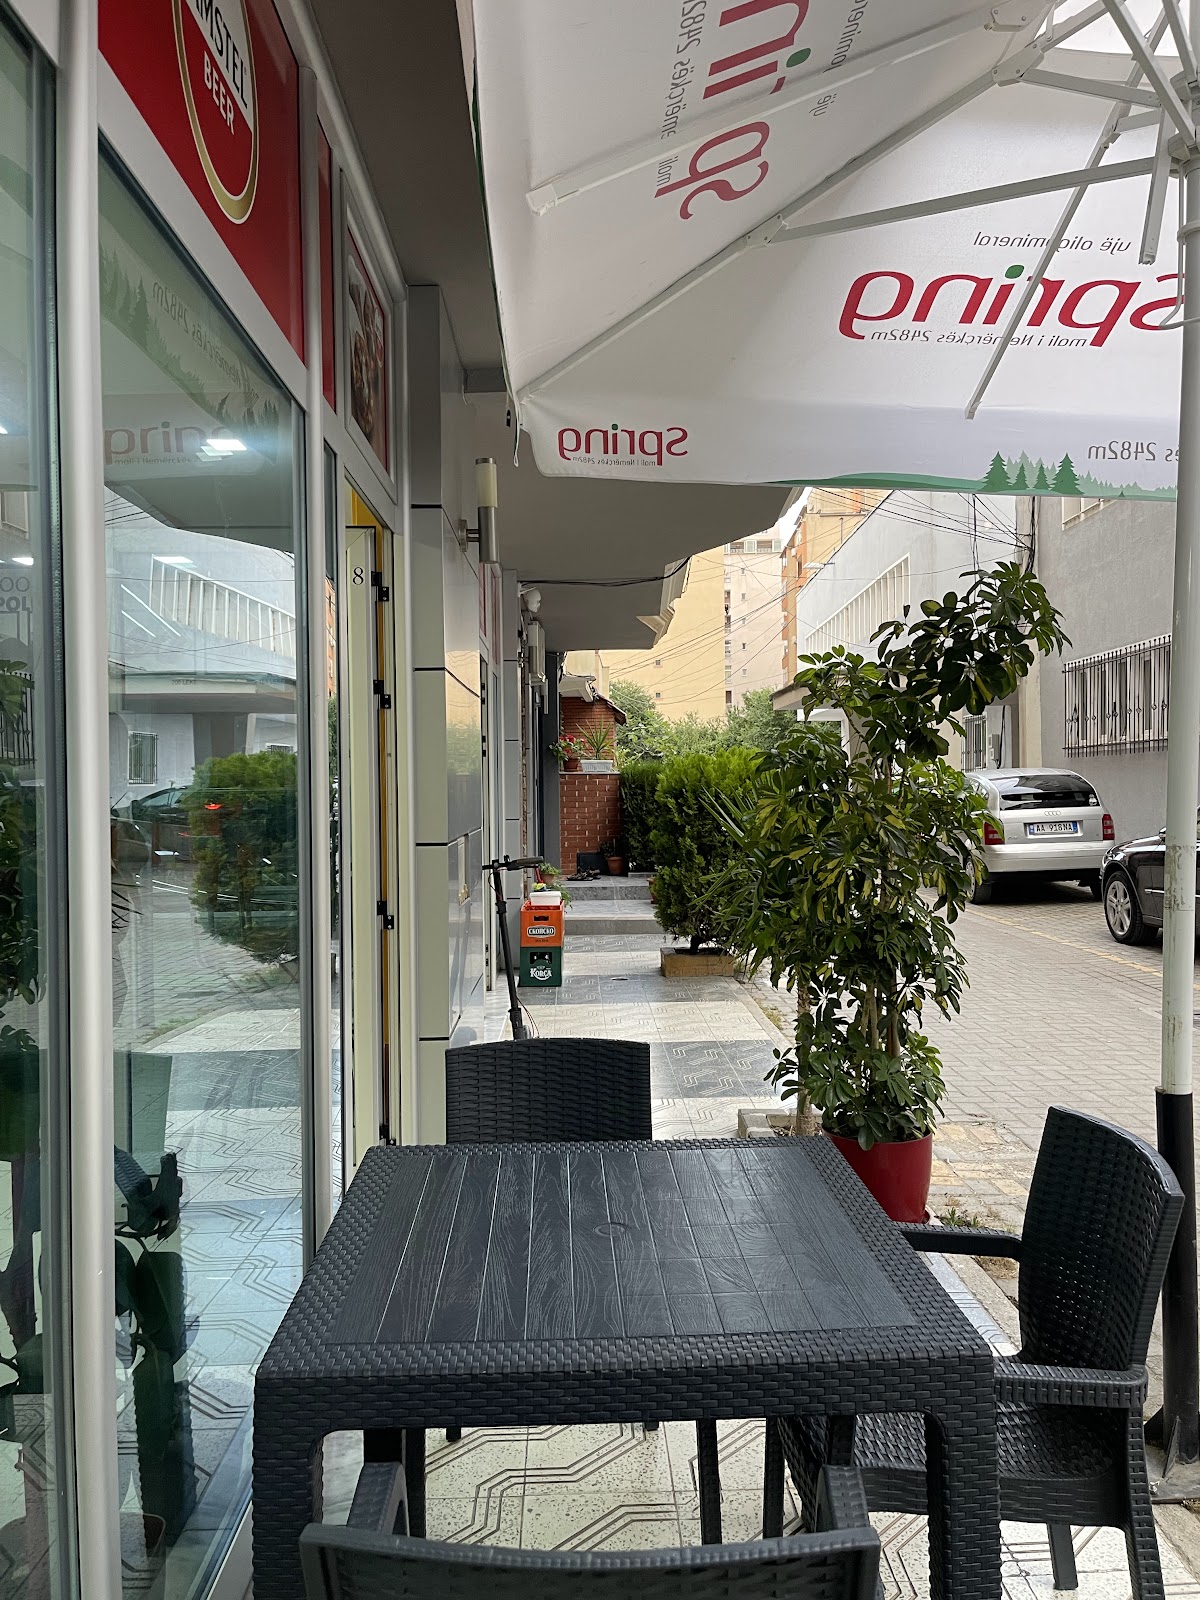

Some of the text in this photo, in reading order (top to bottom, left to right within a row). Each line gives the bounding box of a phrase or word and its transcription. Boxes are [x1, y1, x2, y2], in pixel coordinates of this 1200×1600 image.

[204, 50, 234, 135] BEER
[352, 566, 364, 585] 8
[1036, 824, 1045, 832] AA
